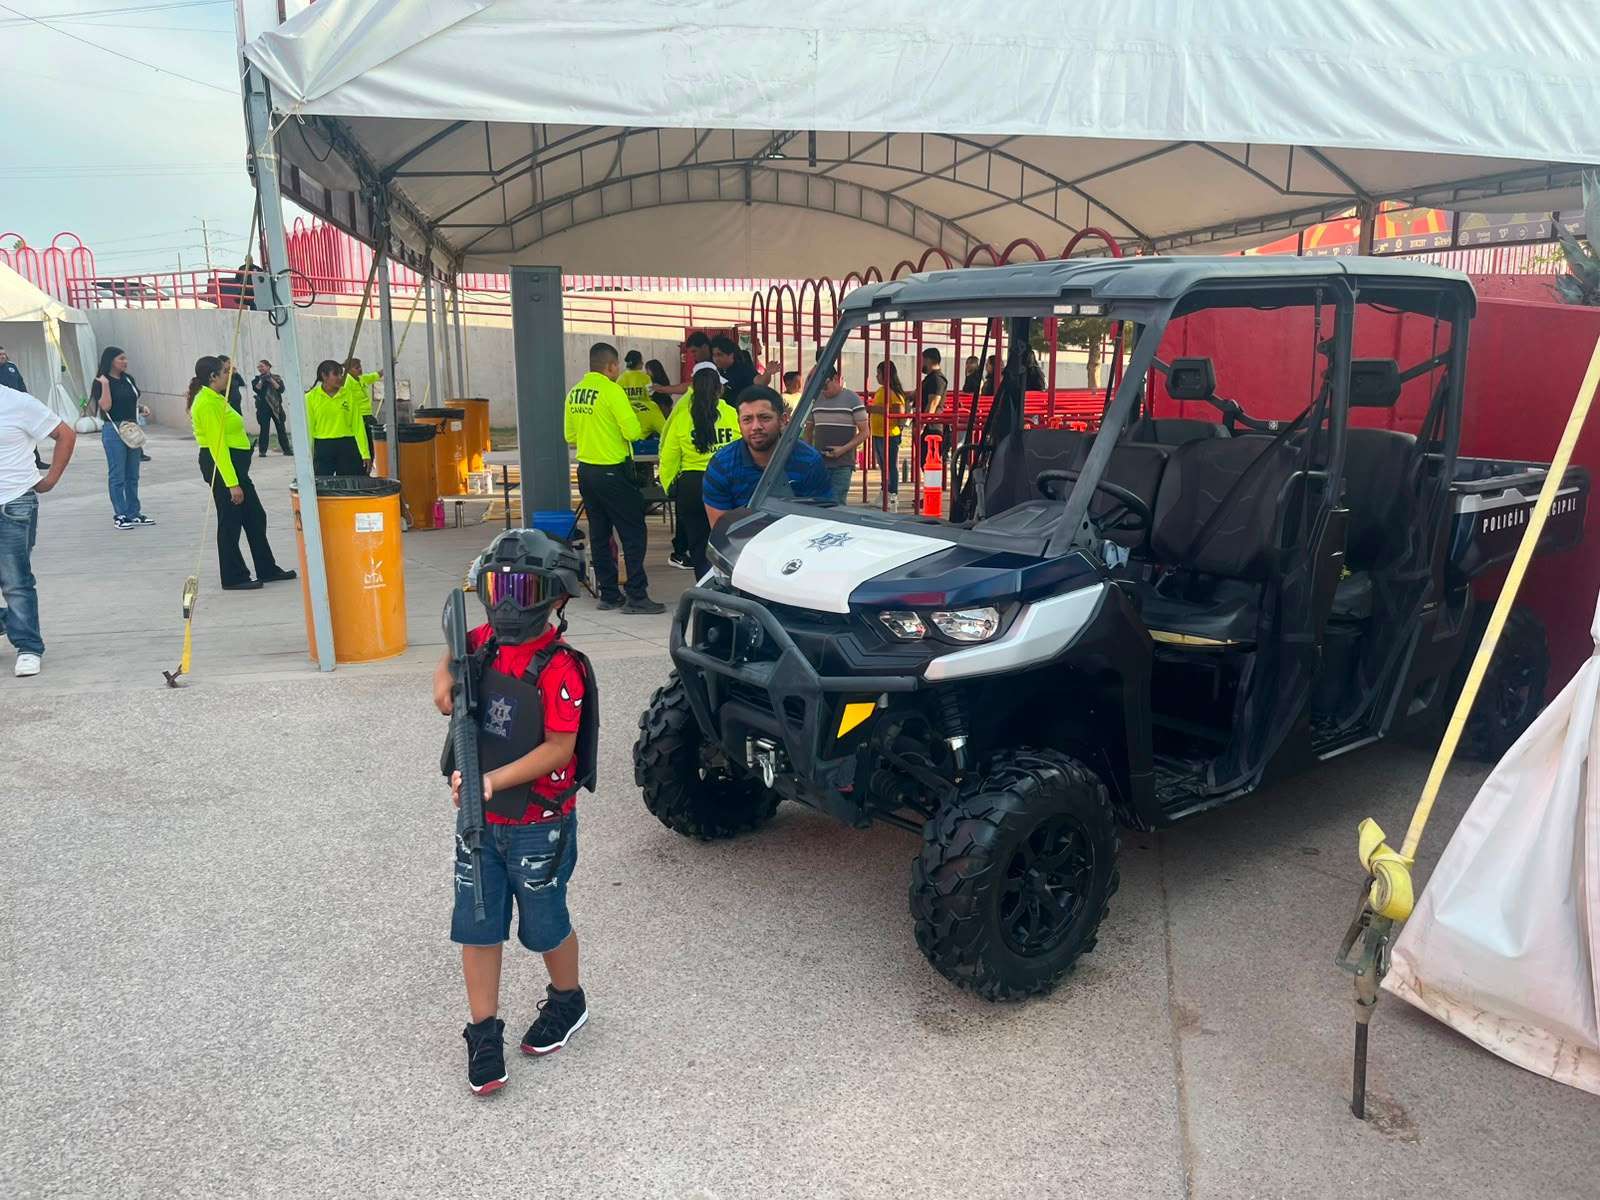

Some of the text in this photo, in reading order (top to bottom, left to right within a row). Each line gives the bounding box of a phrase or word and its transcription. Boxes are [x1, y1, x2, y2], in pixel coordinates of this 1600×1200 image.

[569, 388, 599, 406] STAFF
[1483, 498, 1577, 533] POLICÍA CIPAL
